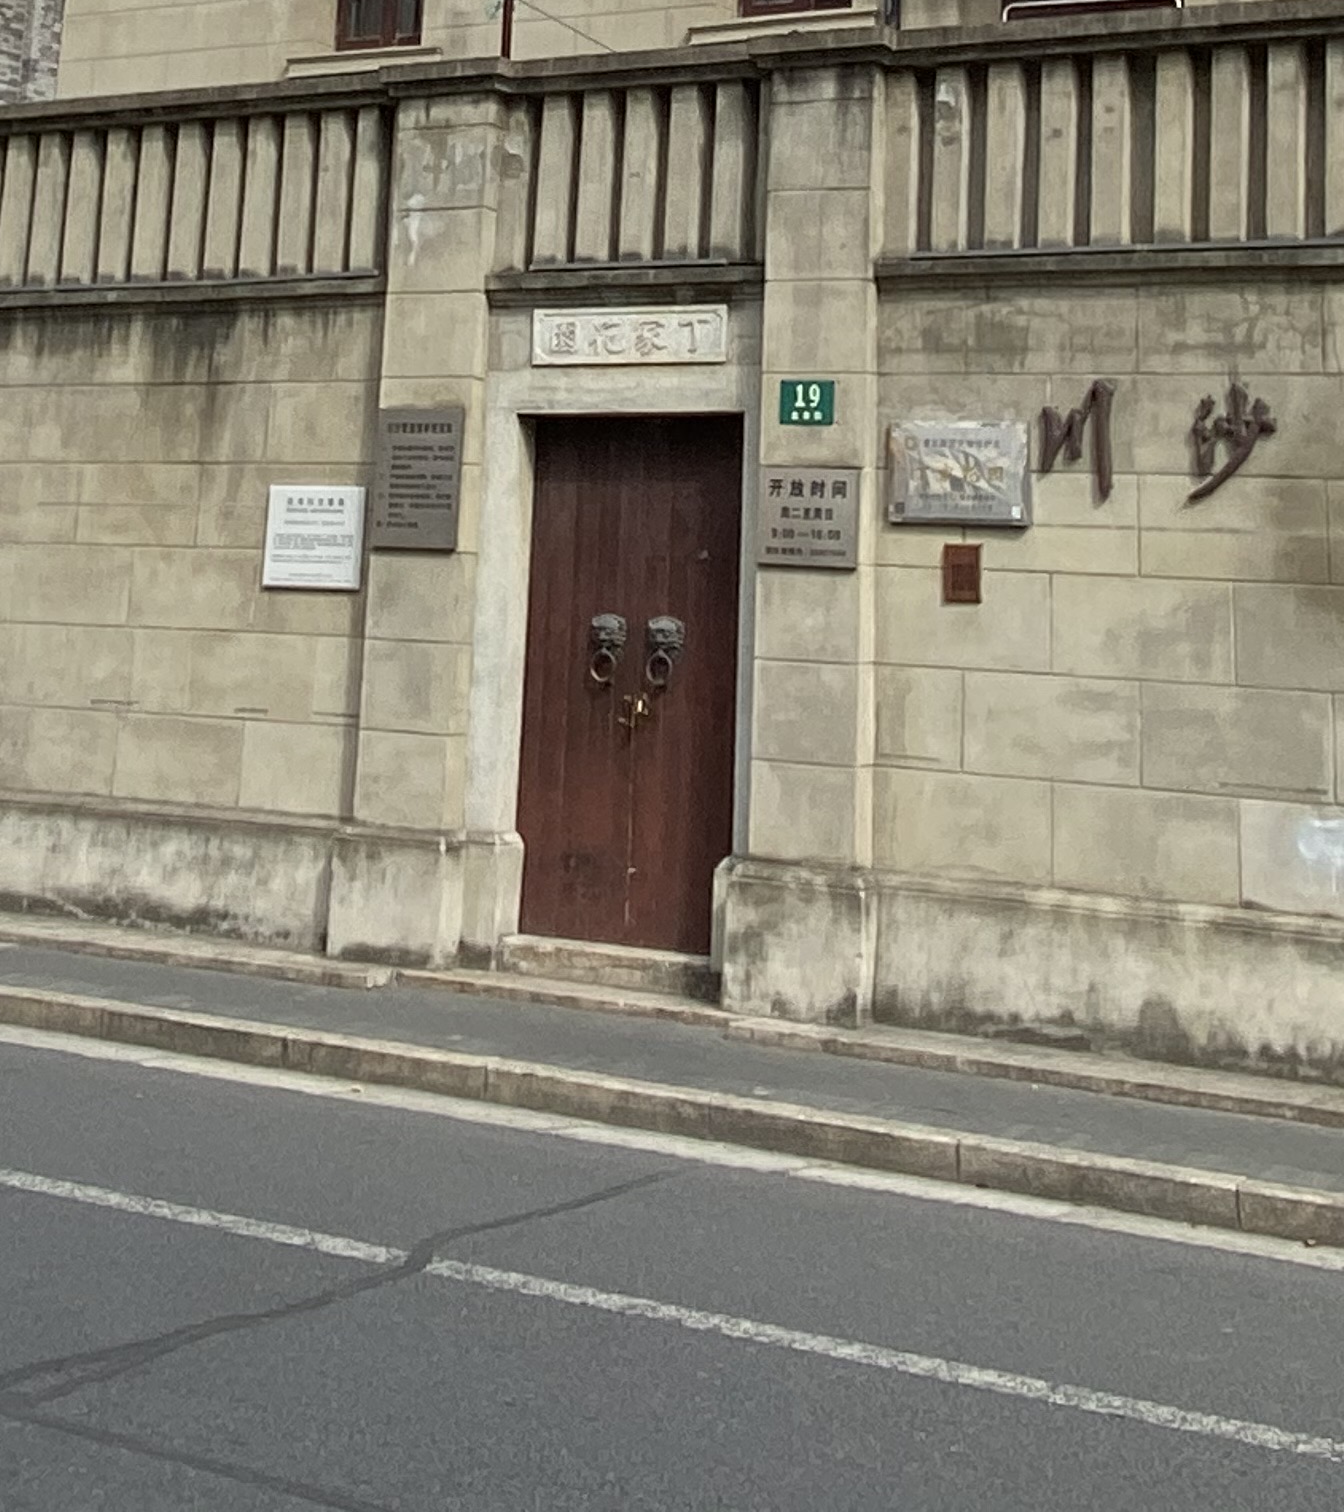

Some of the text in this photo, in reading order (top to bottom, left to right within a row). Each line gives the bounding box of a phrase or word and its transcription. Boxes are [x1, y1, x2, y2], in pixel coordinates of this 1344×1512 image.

[794, 383, 821, 408] 19
[768, 479, 847, 499] 开放时间
